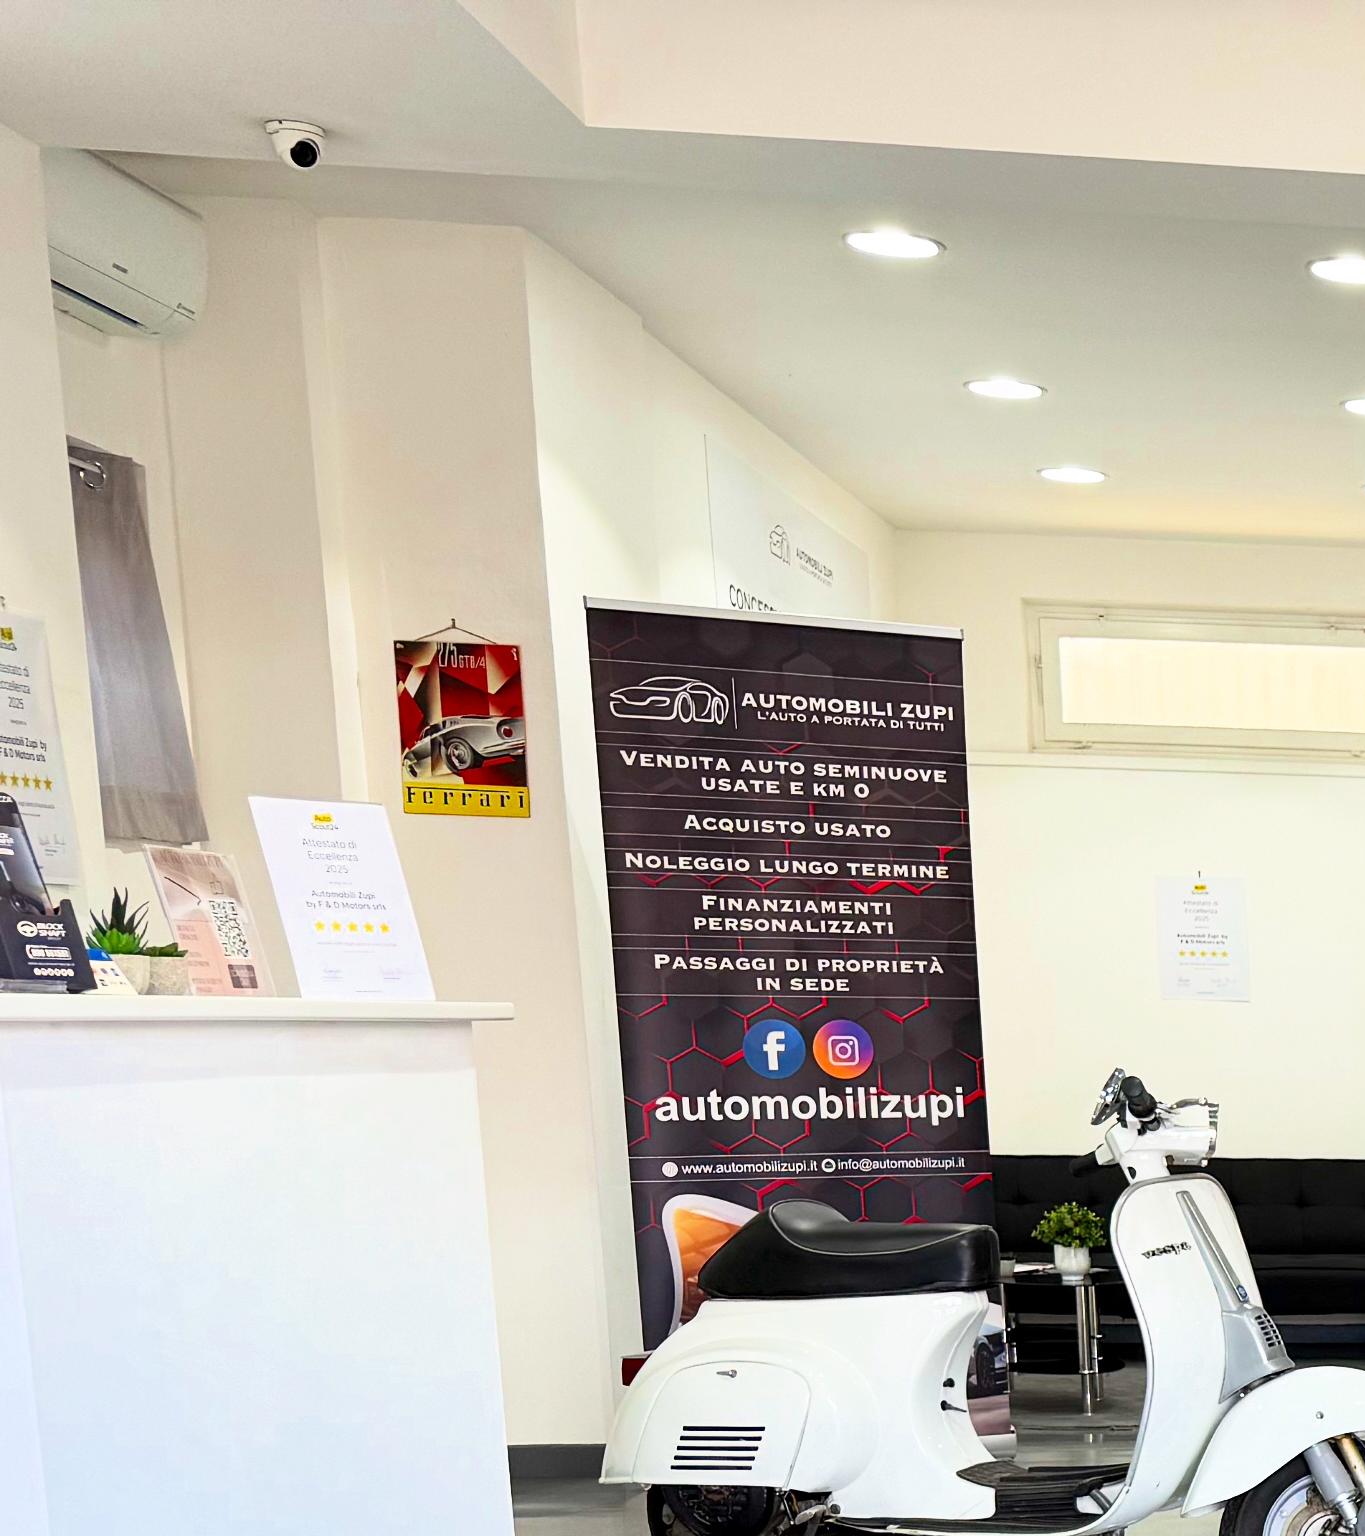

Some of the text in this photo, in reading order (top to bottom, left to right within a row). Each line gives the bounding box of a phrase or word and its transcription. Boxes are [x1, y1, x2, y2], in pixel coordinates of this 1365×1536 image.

[459, 655, 486, 669] GTB/4
[741, 692, 954, 721] AUTOMOBILI ZUPI
[757, 711, 944, 732] L'AUTO A PORTATA DI TUTTI
[619, 750, 947, 784] VENDITA AUTO SEMINUOVE
[406, 786, 525, 808] Ferrari
[700, 777, 780, 794] USATE
[789, 781, 804, 795] E
[813, 783, 845, 798] KM
[684, 814, 892, 839] ACQUISTO USATO
[307, 850, 359, 862] Eccellenza
[625, 852, 950, 880] NOLEGGIO LUNGO TERMINE
[325, 864, 349, 874] 2025
[701, 895, 892, 916] FINANZIAMENTI
[693, 917, 894, 935] PERSONALIZZATI
[653, 953, 944, 974] PASSAGGI DI PROPRIETÀ
[756, 977, 850, 992] IN SEDE
[654, 1086, 965, 1126] automobilizupi
[681, 1156, 965, 1175] www.automobilizupi.it info@automobilizupi.it
